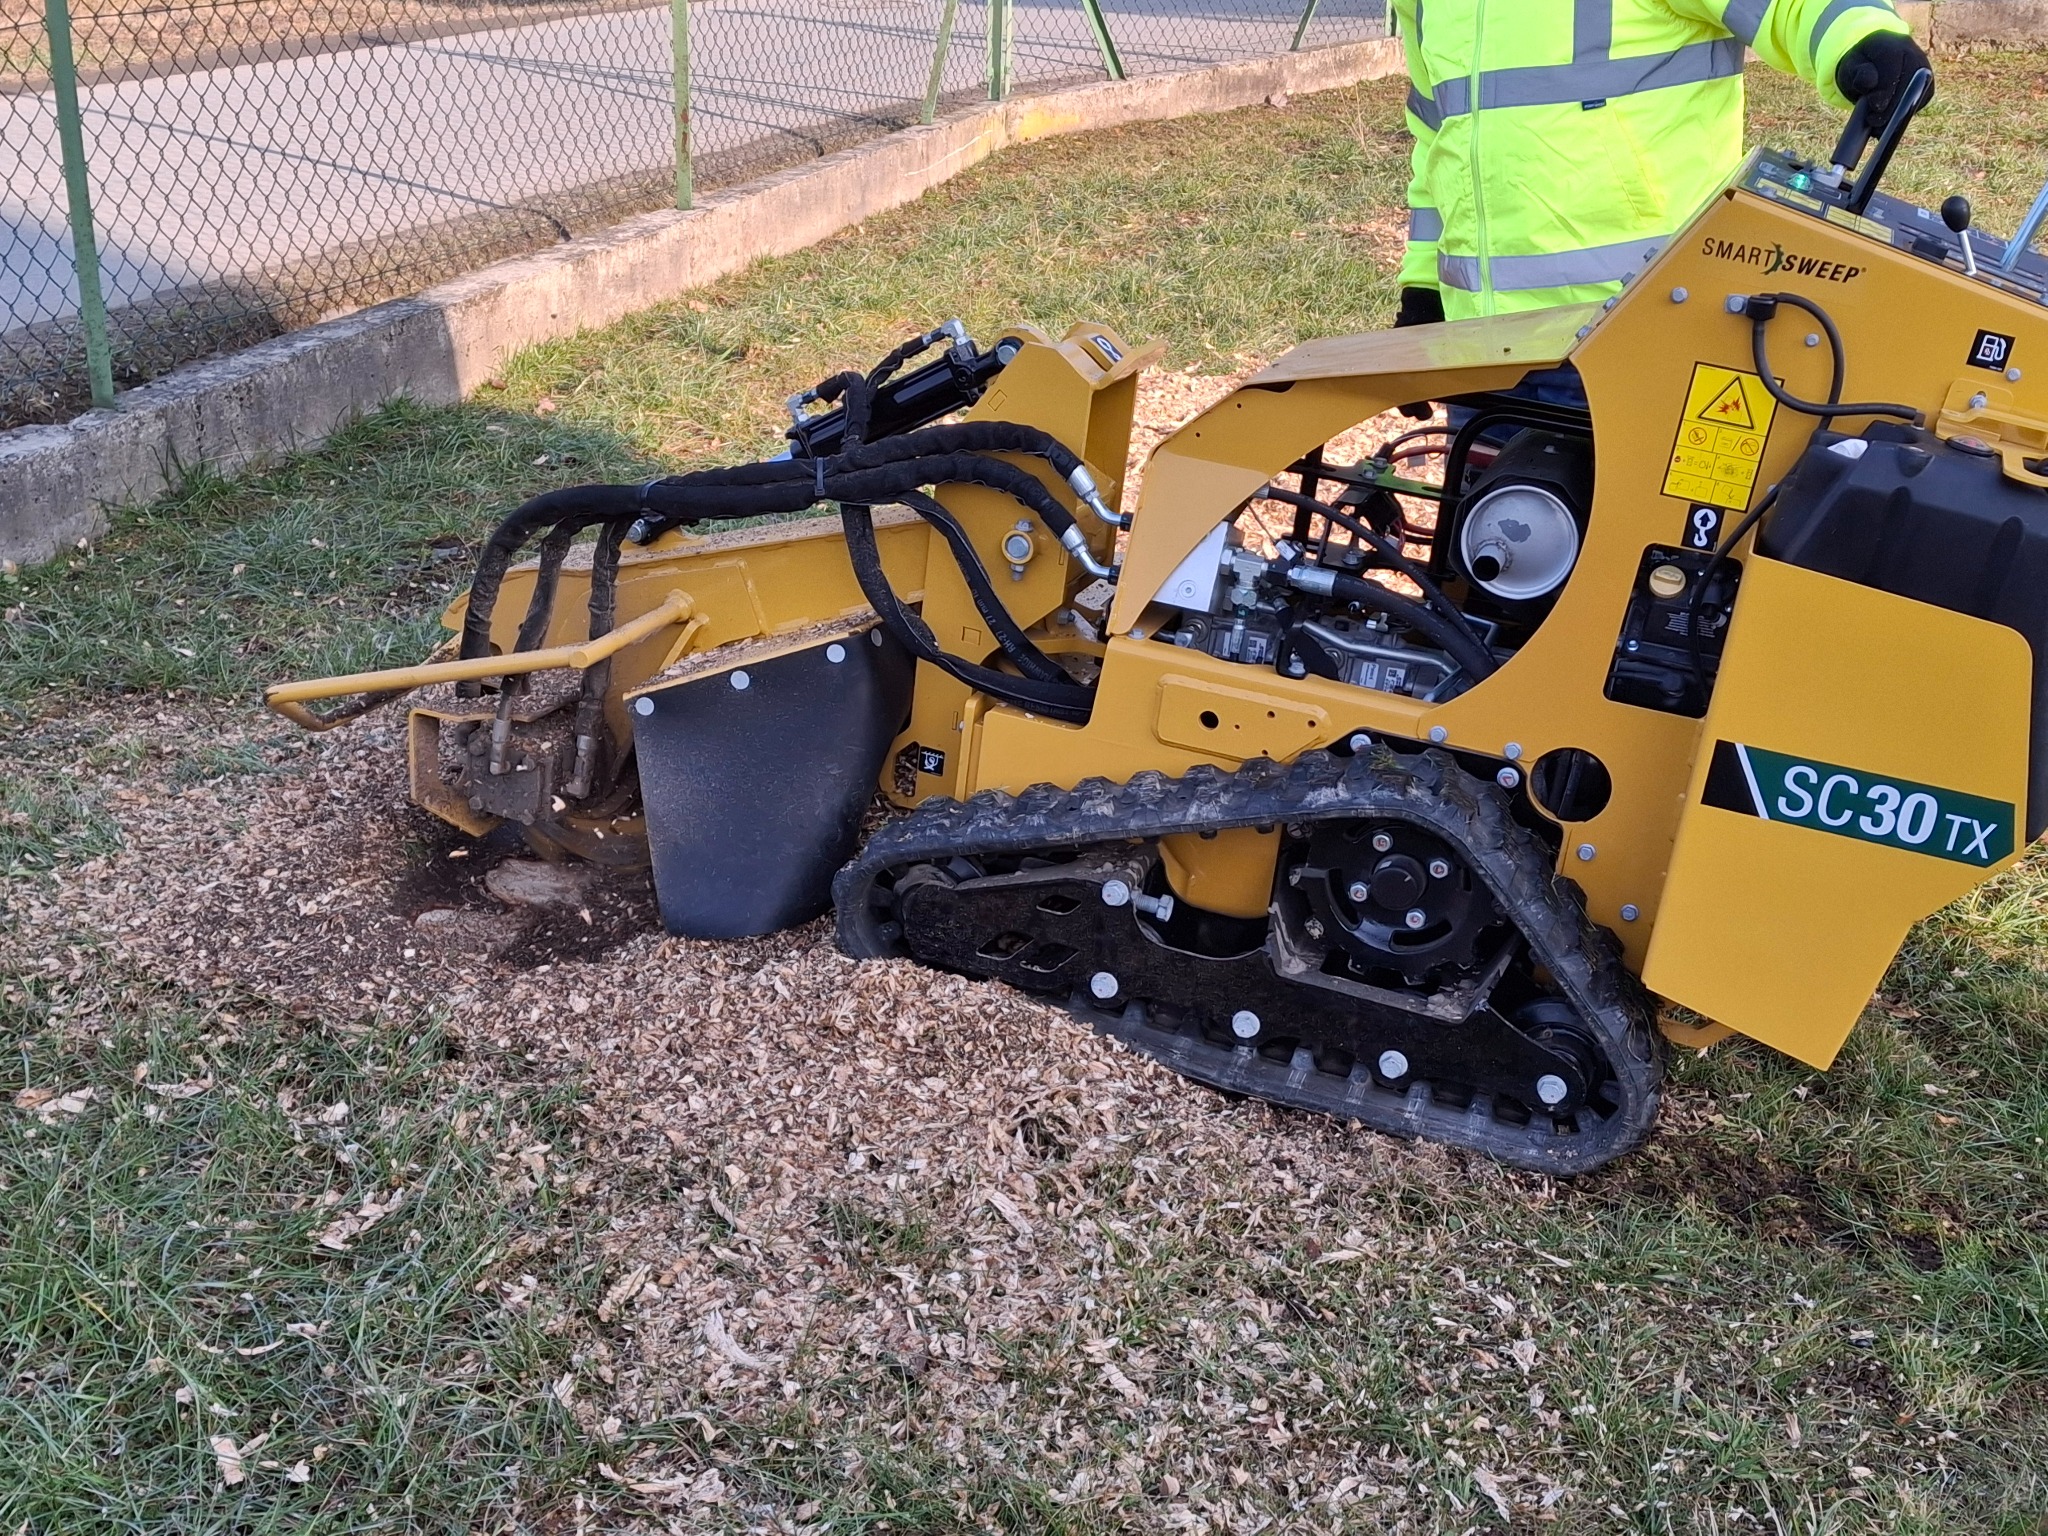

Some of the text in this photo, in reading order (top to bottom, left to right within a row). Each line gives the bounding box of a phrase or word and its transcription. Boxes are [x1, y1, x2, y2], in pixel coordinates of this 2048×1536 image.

[1702, 237, 1776, 268] SMART
[1777, 765, 1998, 860] SC30 TX
